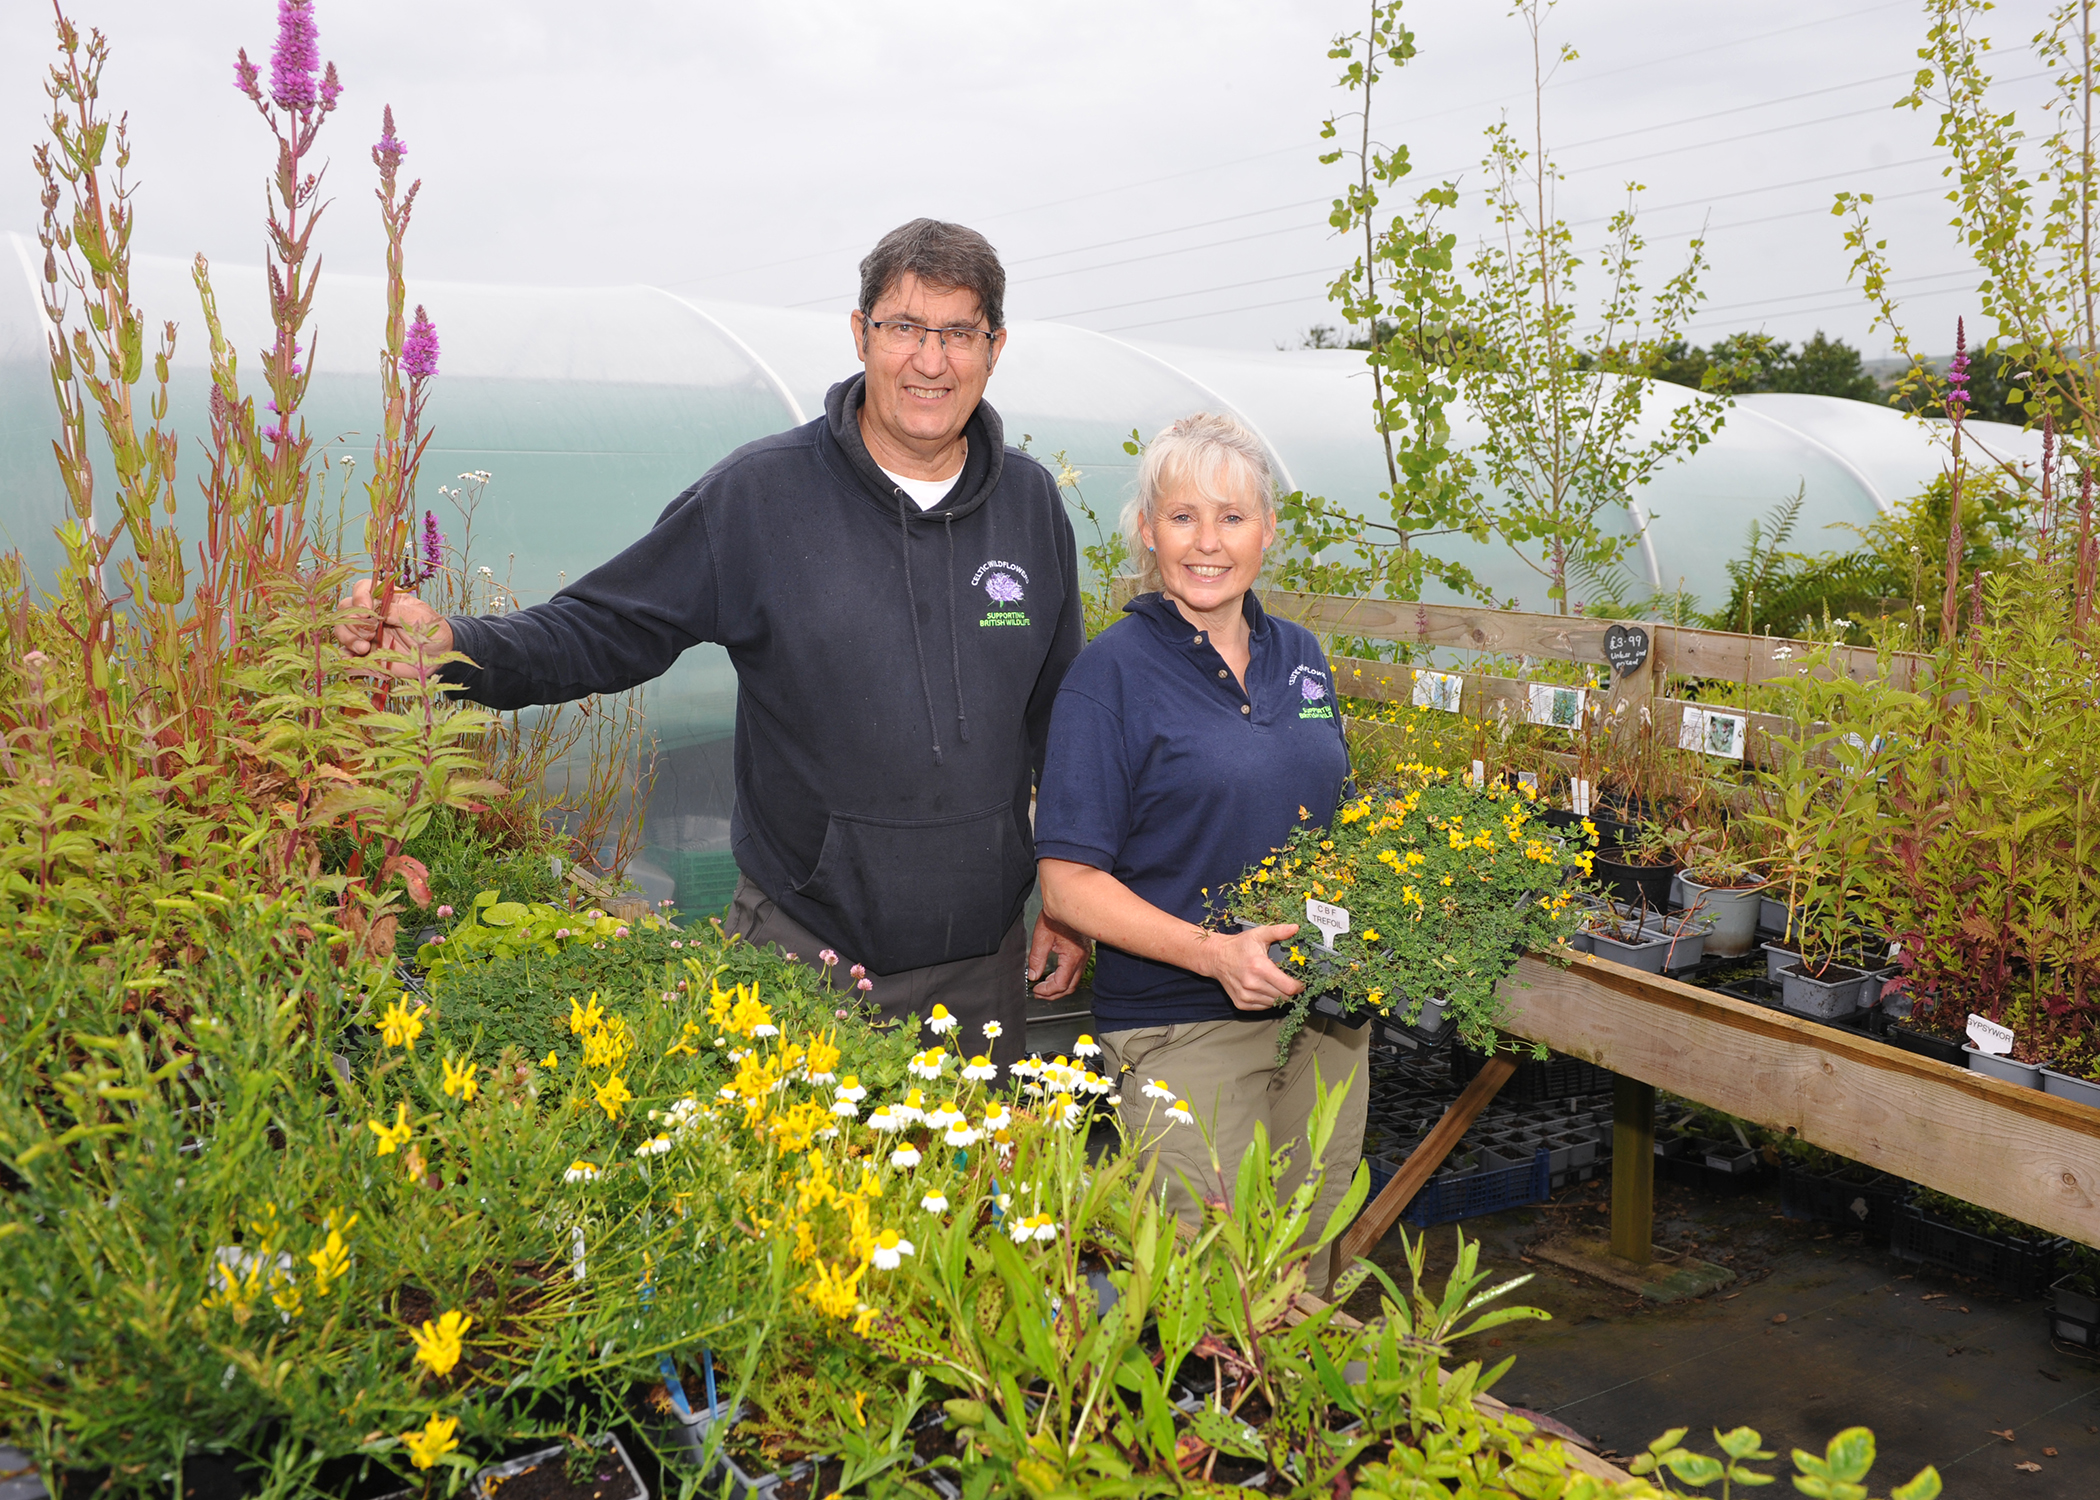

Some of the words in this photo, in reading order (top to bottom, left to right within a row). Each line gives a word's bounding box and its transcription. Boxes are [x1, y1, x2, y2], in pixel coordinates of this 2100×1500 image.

[971, 563, 989, 586] CELTIC
[979, 619, 1005, 627] BRITISH
[1312, 914, 1343, 929] TREFOIL
[1967, 1018, 2013, 1042] GYPSYWOR
